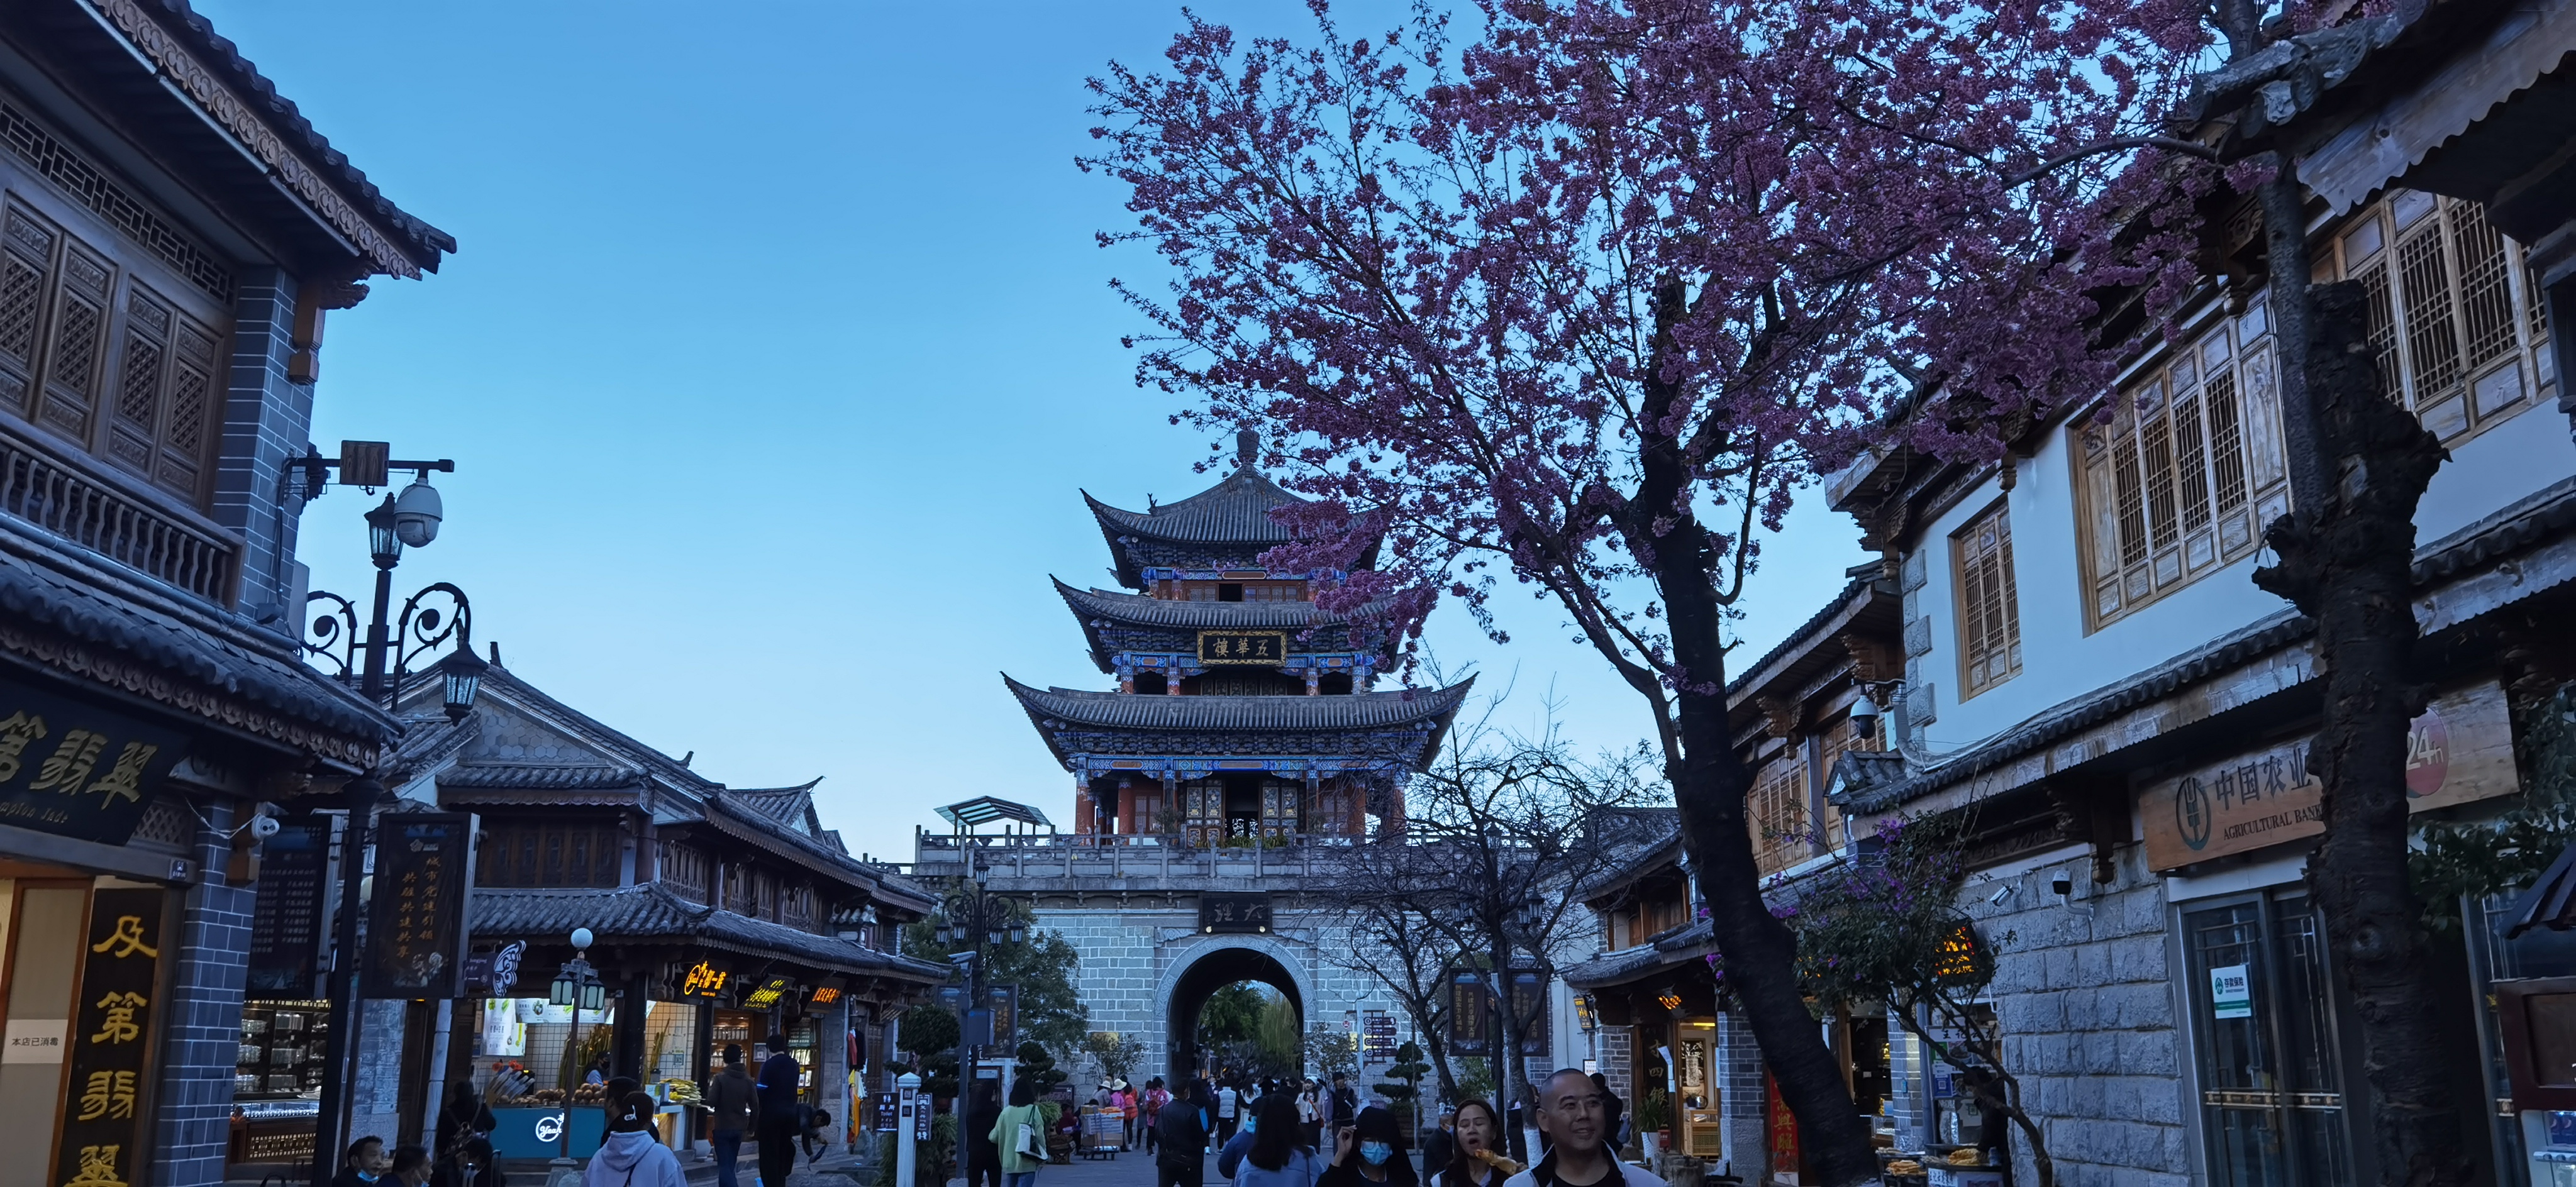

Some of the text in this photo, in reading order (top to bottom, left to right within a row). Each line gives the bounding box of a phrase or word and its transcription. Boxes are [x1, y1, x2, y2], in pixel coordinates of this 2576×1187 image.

[1213, 637, 1269, 658] 五華樓
[2406, 726, 2444, 771] 24h
[2215, 748, 2313, 811] 中国农业
[2224, 812, 2292, 841] AGRICULTURAL
[1214, 902, 1264, 923] 大理
[2224, 976, 2244, 988] 存款保险
[11, 1037, 58, 1047] 本店已消毒
[64, 915, 157, 1187] 及第翡翠
[1648, 1039, 1670, 1127] 寸四银
[539, 1122, 563, 1138] Yeah
